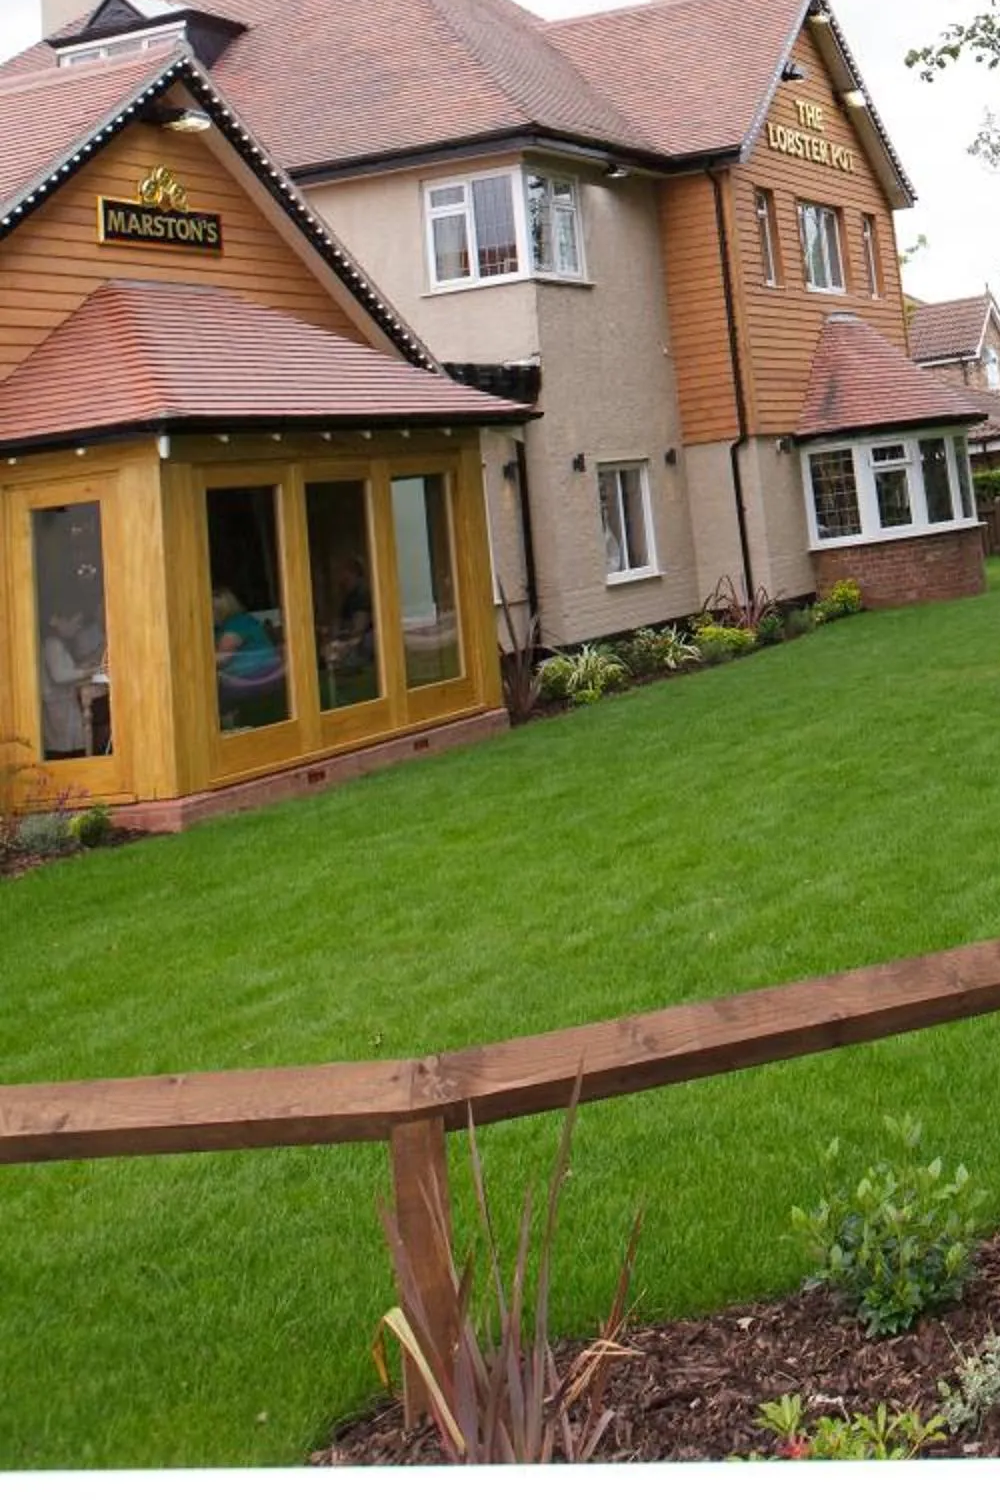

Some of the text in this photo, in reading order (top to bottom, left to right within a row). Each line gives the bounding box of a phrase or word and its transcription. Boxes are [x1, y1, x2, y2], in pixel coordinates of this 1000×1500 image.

[795, 99, 824, 131] THE
[767, 121, 856, 172] LOBSTER POT
[107, 209, 218, 243] MARSTON'S
